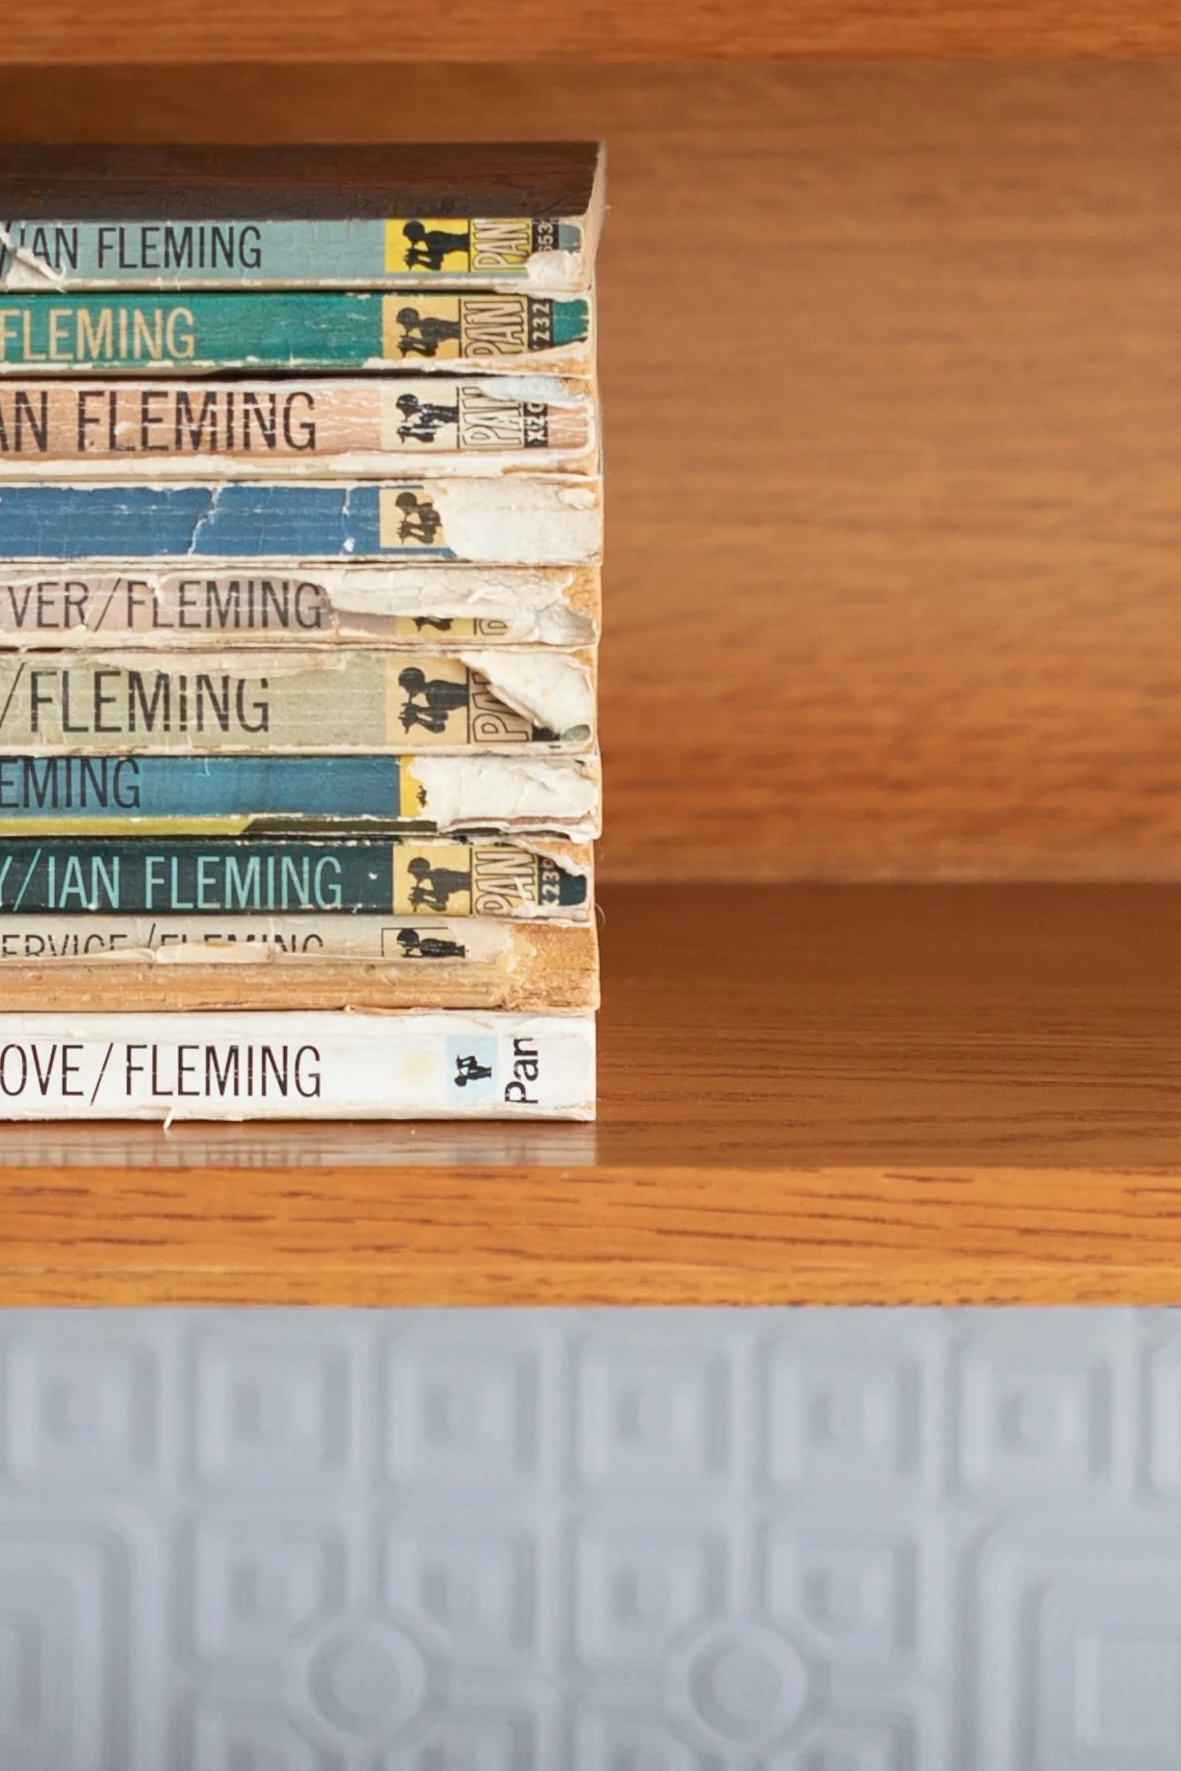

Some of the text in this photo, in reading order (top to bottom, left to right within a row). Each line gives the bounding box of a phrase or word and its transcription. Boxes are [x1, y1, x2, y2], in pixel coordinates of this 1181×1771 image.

[98, 225, 263, 269] FLEMING
[532, 302, 551, 351] 232
[77, 390, 316, 452] FLEMING
[144, 855, 343, 911] FLEMING
[504, 1037, 540, 1105] Pan
